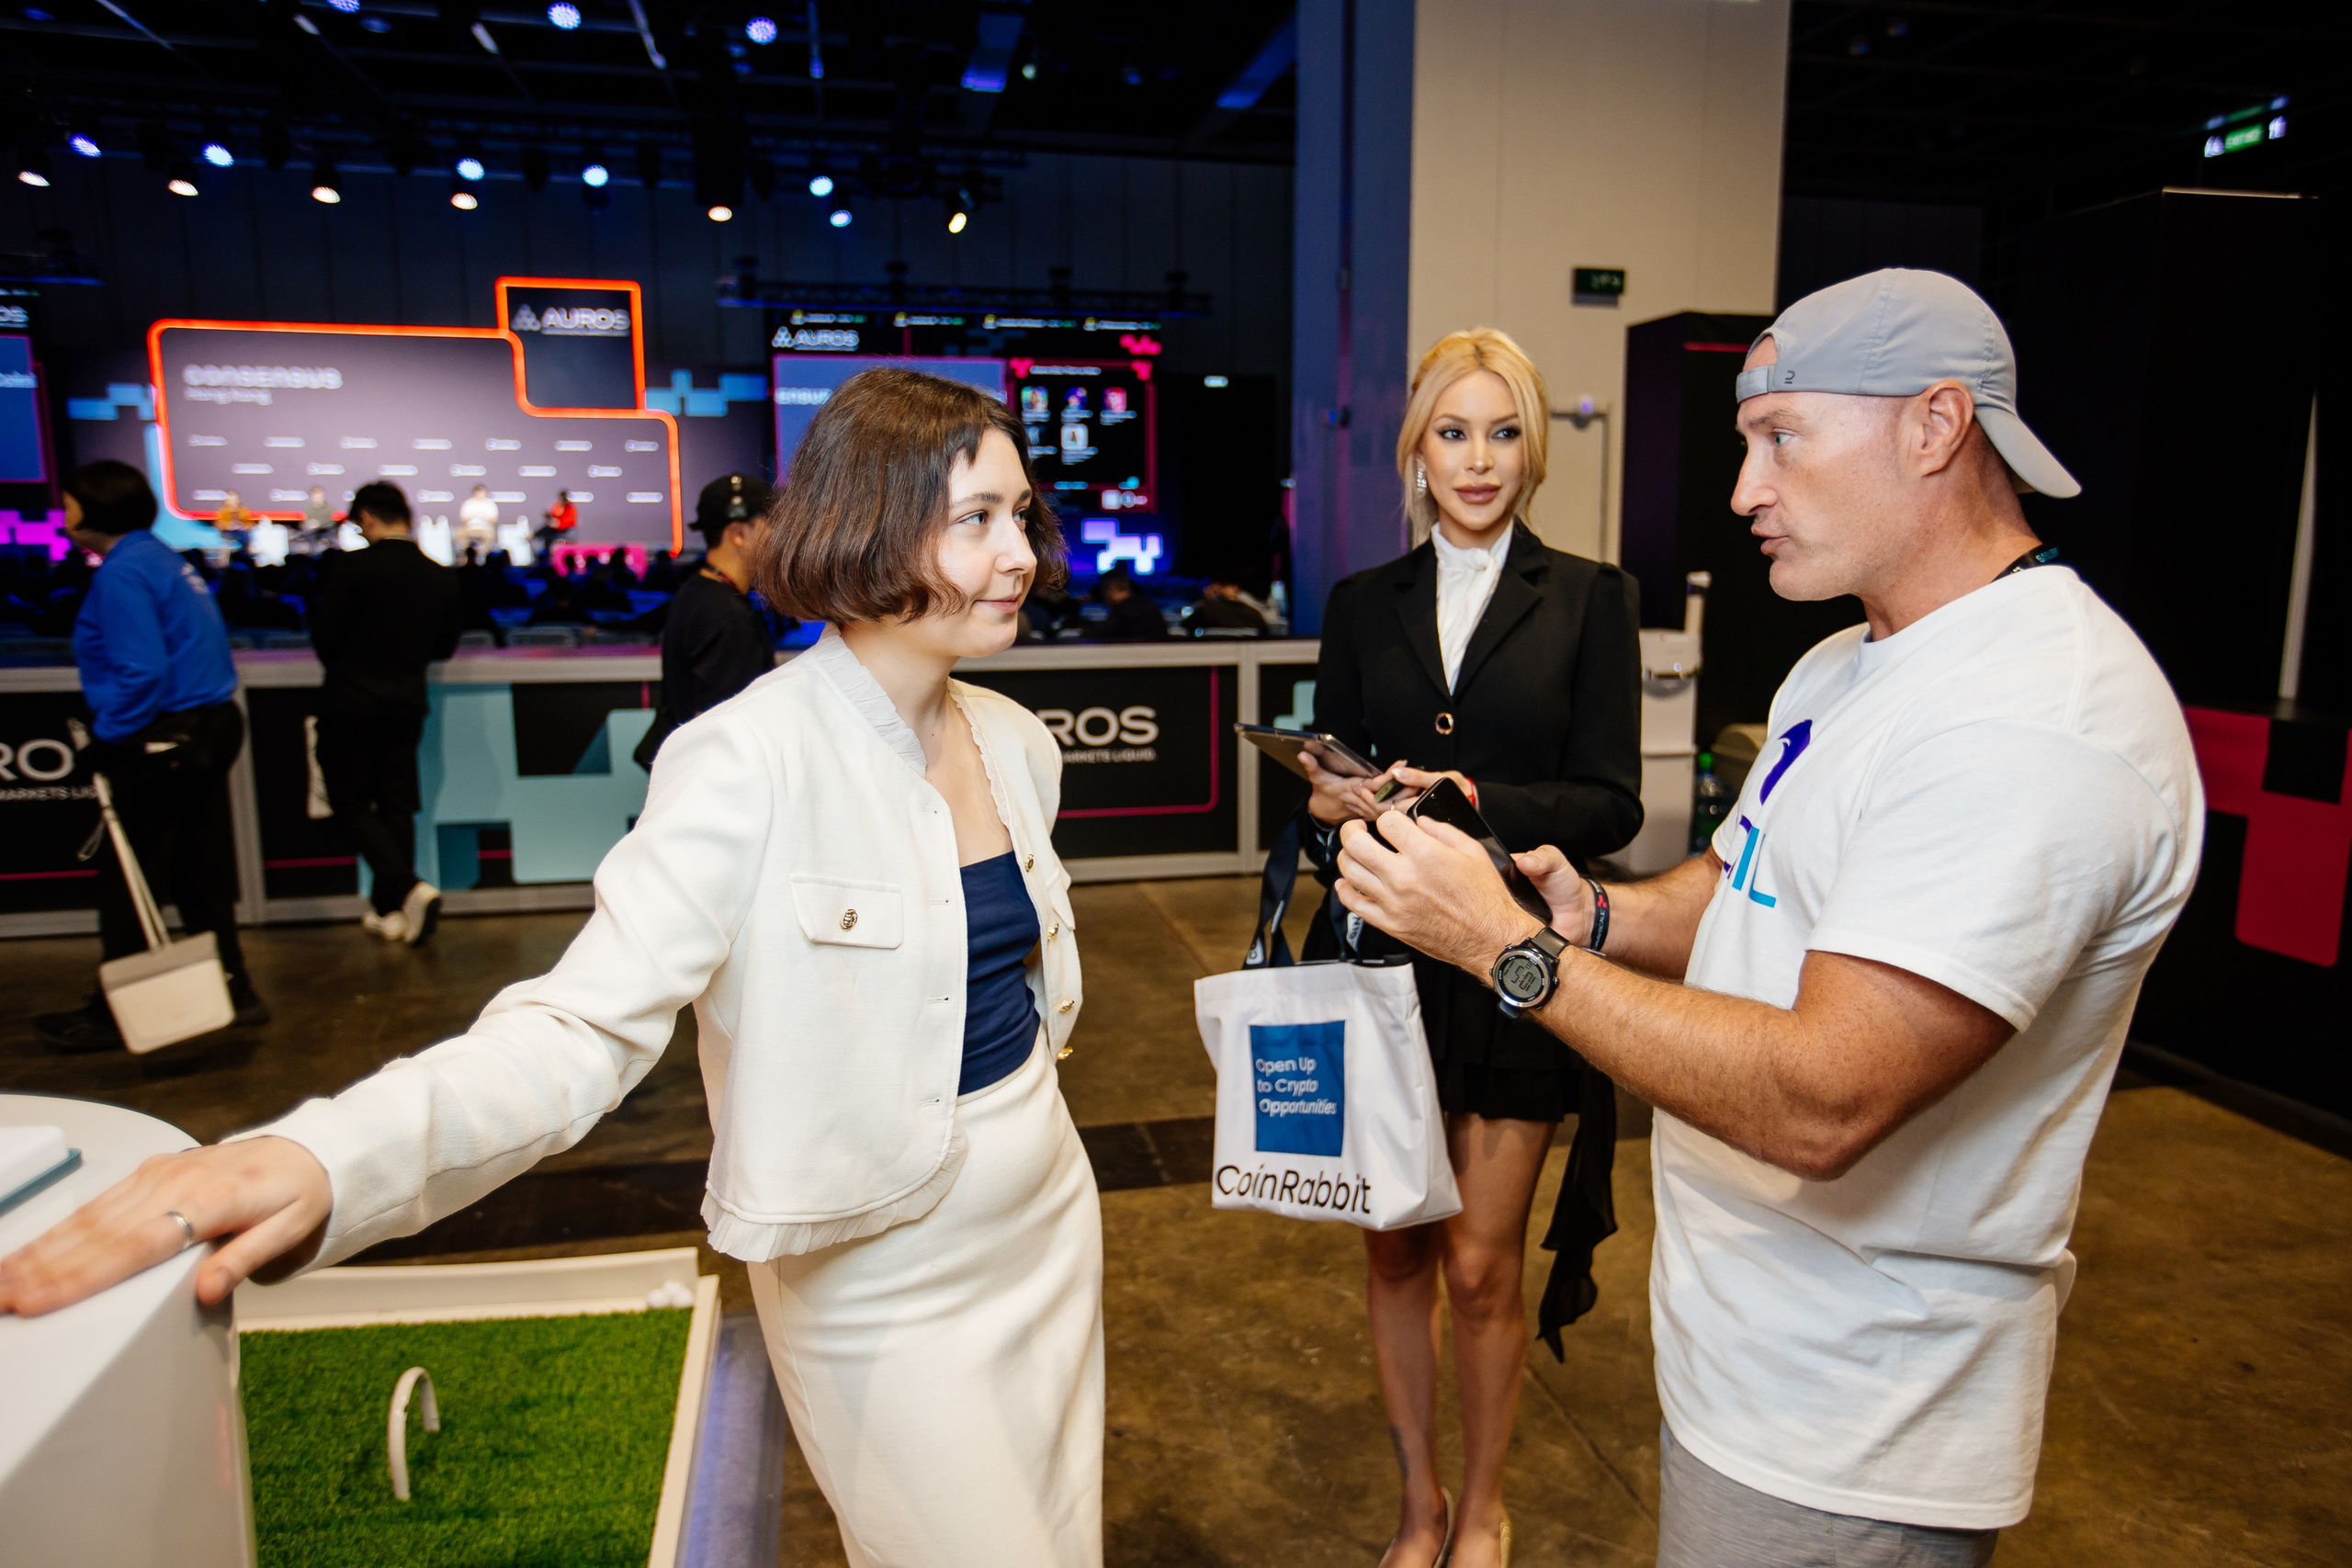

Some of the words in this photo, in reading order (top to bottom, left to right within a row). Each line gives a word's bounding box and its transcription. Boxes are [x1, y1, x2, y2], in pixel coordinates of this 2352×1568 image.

[1035, 705, 1159, 747] ROS
[1255, 1057, 1297, 1077] Open
[1298, 1056, 1317, 1076] Up
[1257, 1078, 1273, 1093] to
[1274, 1077, 1319, 1097] Crypto
[1259, 1098, 1338, 1118] Opportunities
[1216, 1163, 1372, 1214] CoinRabbit
